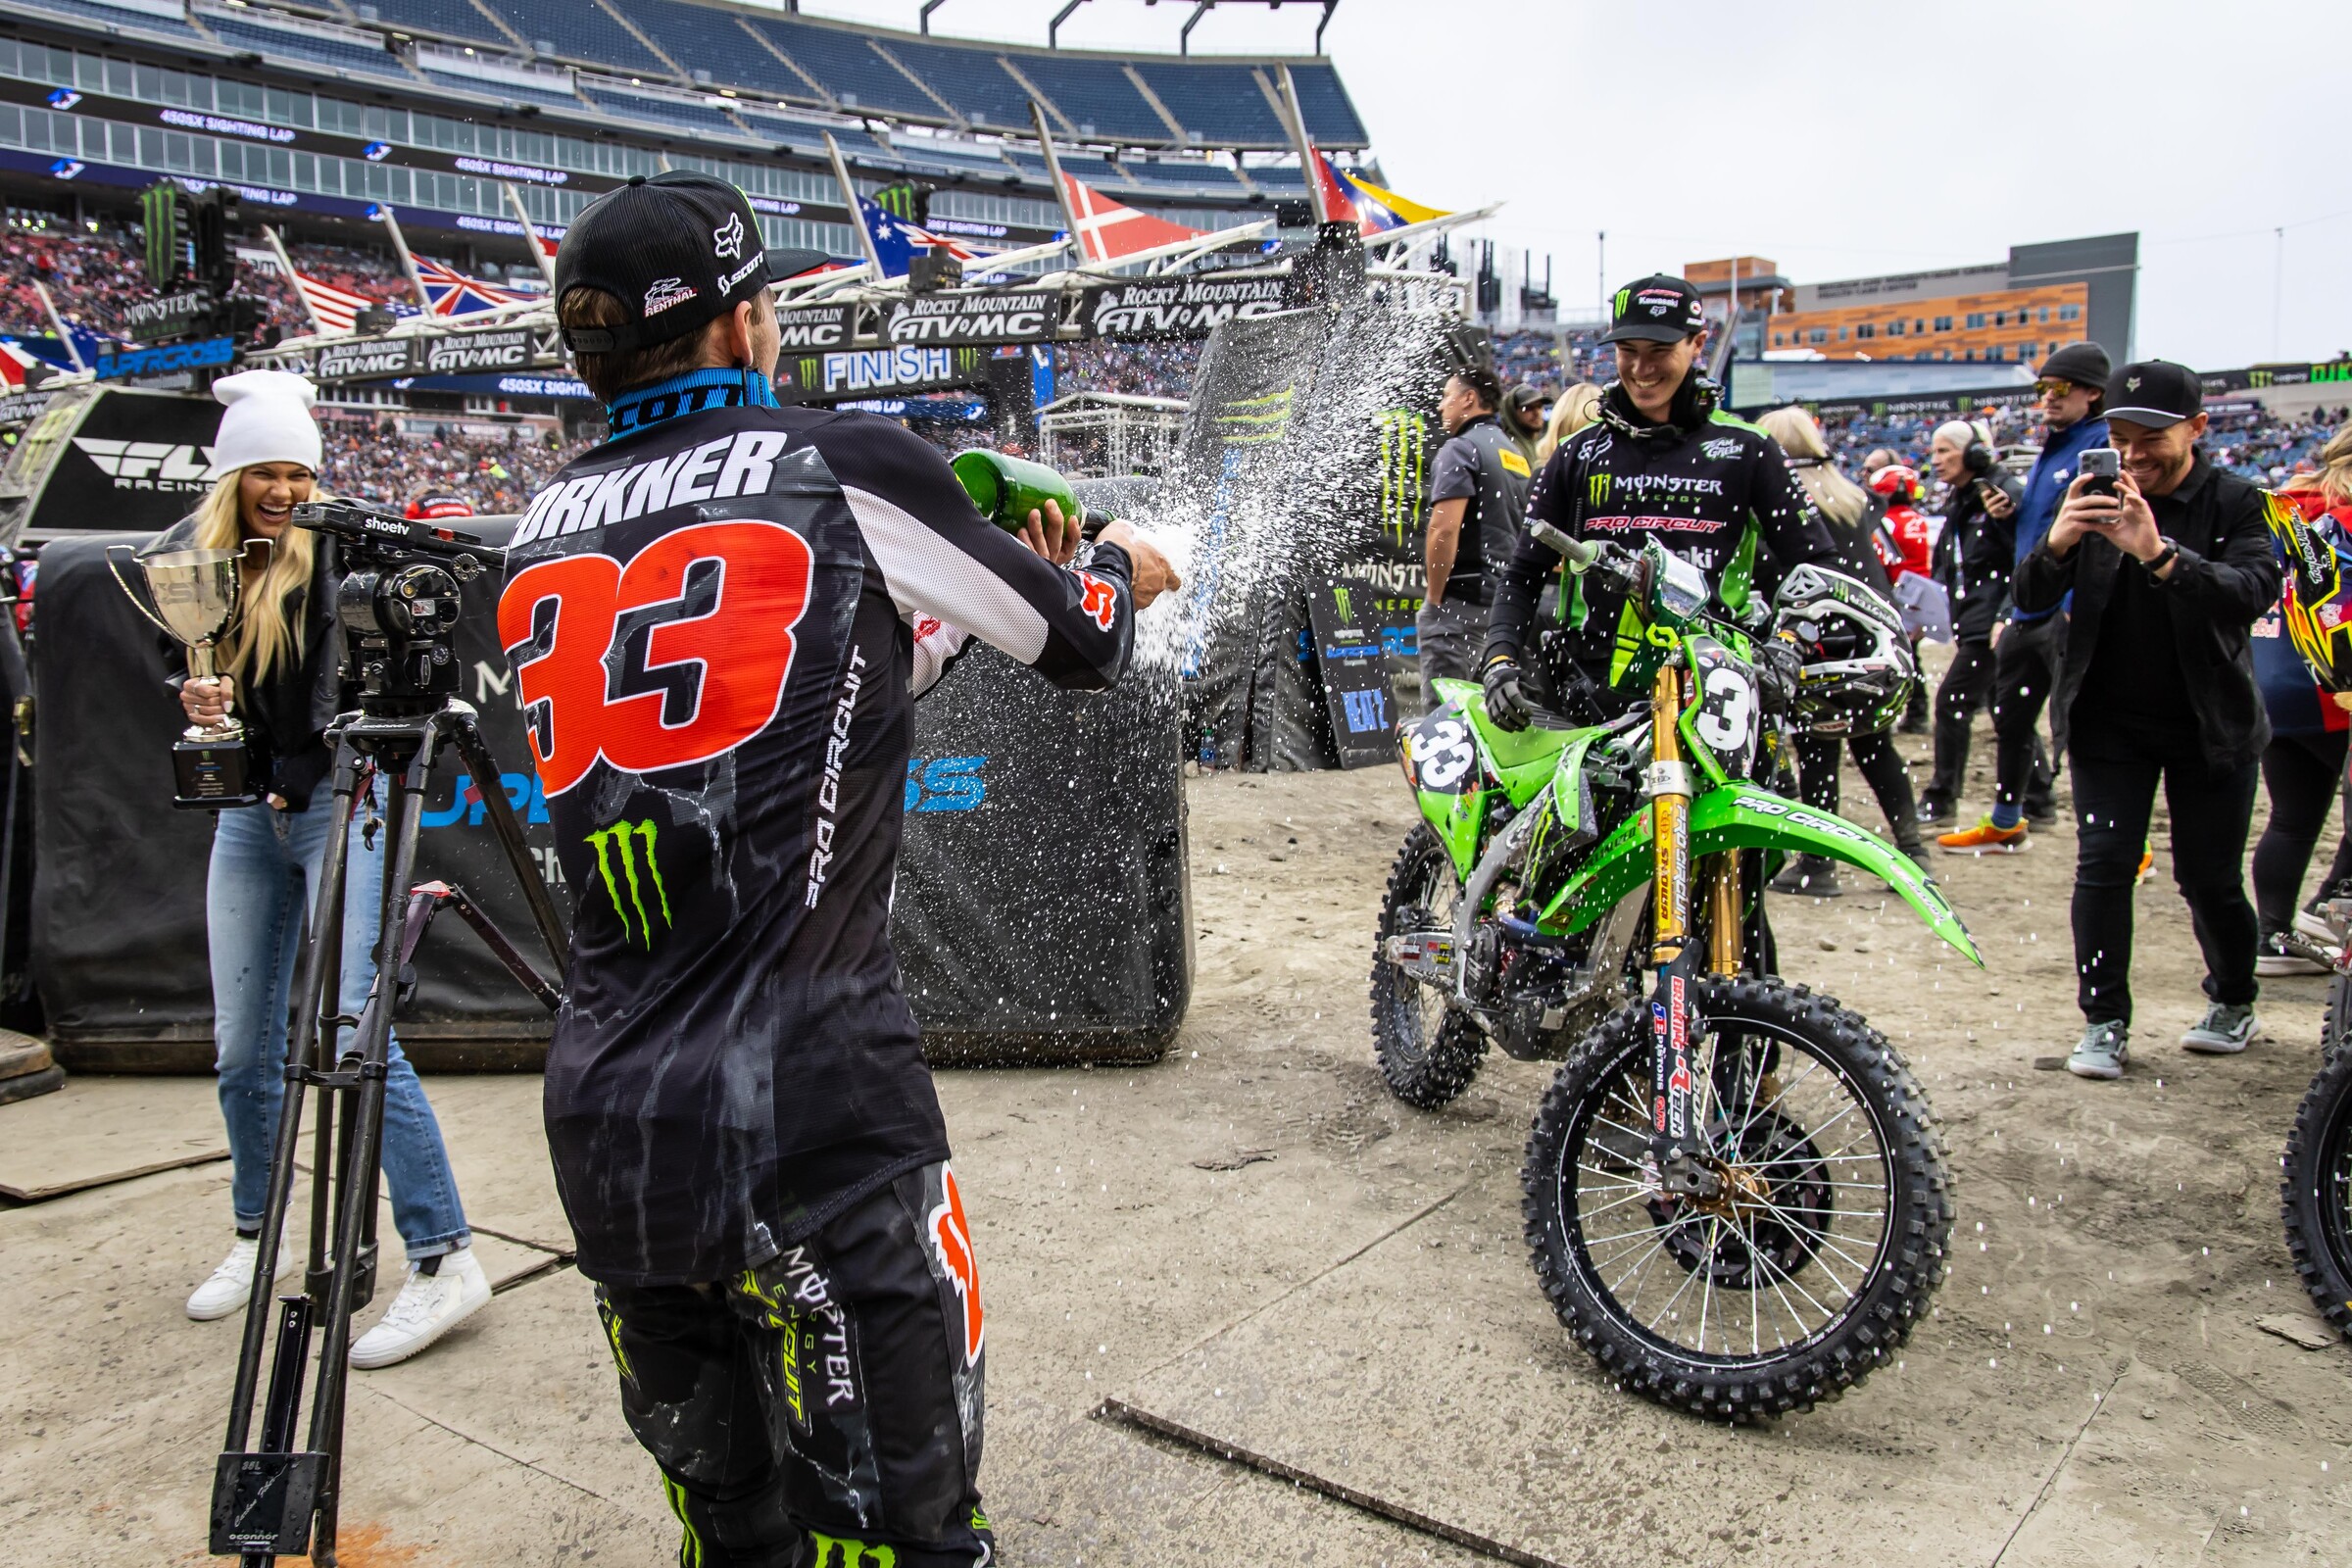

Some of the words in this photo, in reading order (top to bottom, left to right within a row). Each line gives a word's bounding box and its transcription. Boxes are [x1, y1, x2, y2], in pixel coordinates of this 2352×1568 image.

[160, 109, 204, 128] 450SX
[205, 117, 269, 140] SIGHTING
[269, 125, 295, 143] LAP
[455, 157, 491, 173] 450SX
[492, 163, 544, 182] SIGHTING
[545, 172, 568, 184] LAP
[270, 191, 297, 206] LAP
[780, 202, 801, 215] LAP
[456, 216, 493, 232] 450SX
[949, 221, 989, 236] SIGHTING
[990, 225, 1007, 238] LAP
[730, 250, 763, 286] SCOTT
[645, 290, 698, 318] RENTHAL
[912, 297, 961, 316] ROCKY
[960, 293, 1048, 314] MOUNTAIN
[1120, 286, 1180, 306] ROCKY
[1182, 281, 1286, 304] MOUNTAIN
[776, 307, 845, 325] MOUNTAIN
[332, 343, 360, 358] ROCKY
[360, 339, 409, 355] MOUNTAIN
[443, 334, 473, 351] ROCKY
[473, 330, 526, 347] MOUNTAIN
[823, 344, 952, 392] FINISH
[498, 378, 542, 395] 450SX
[608, 383, 743, 440] COTT
[1707, 444, 1744, 461] GREEN
[1614, 473, 1724, 496] MONSTER
[365, 515, 411, 537] shoetv
[1584, 516, 1630, 531] PRO
[1630, 515, 1724, 534] CIRCUIT
[498, 519, 815, 800] 33
[819, 644, 866, 813] CIRCUIT
[1410, 720, 1474, 787] 33
[1673, 804, 1688, 847] PRO
[1733, 795, 1790, 816] PRO
[1786, 809, 1898, 861] CIRCUIT
[1673, 847, 1688, 931] CIRCUIT
[1651, 1001, 1667, 1035] JE
[1670, 975, 1686, 1053] BRAKING
[1655, 1035, 1667, 1091] PISTONS
